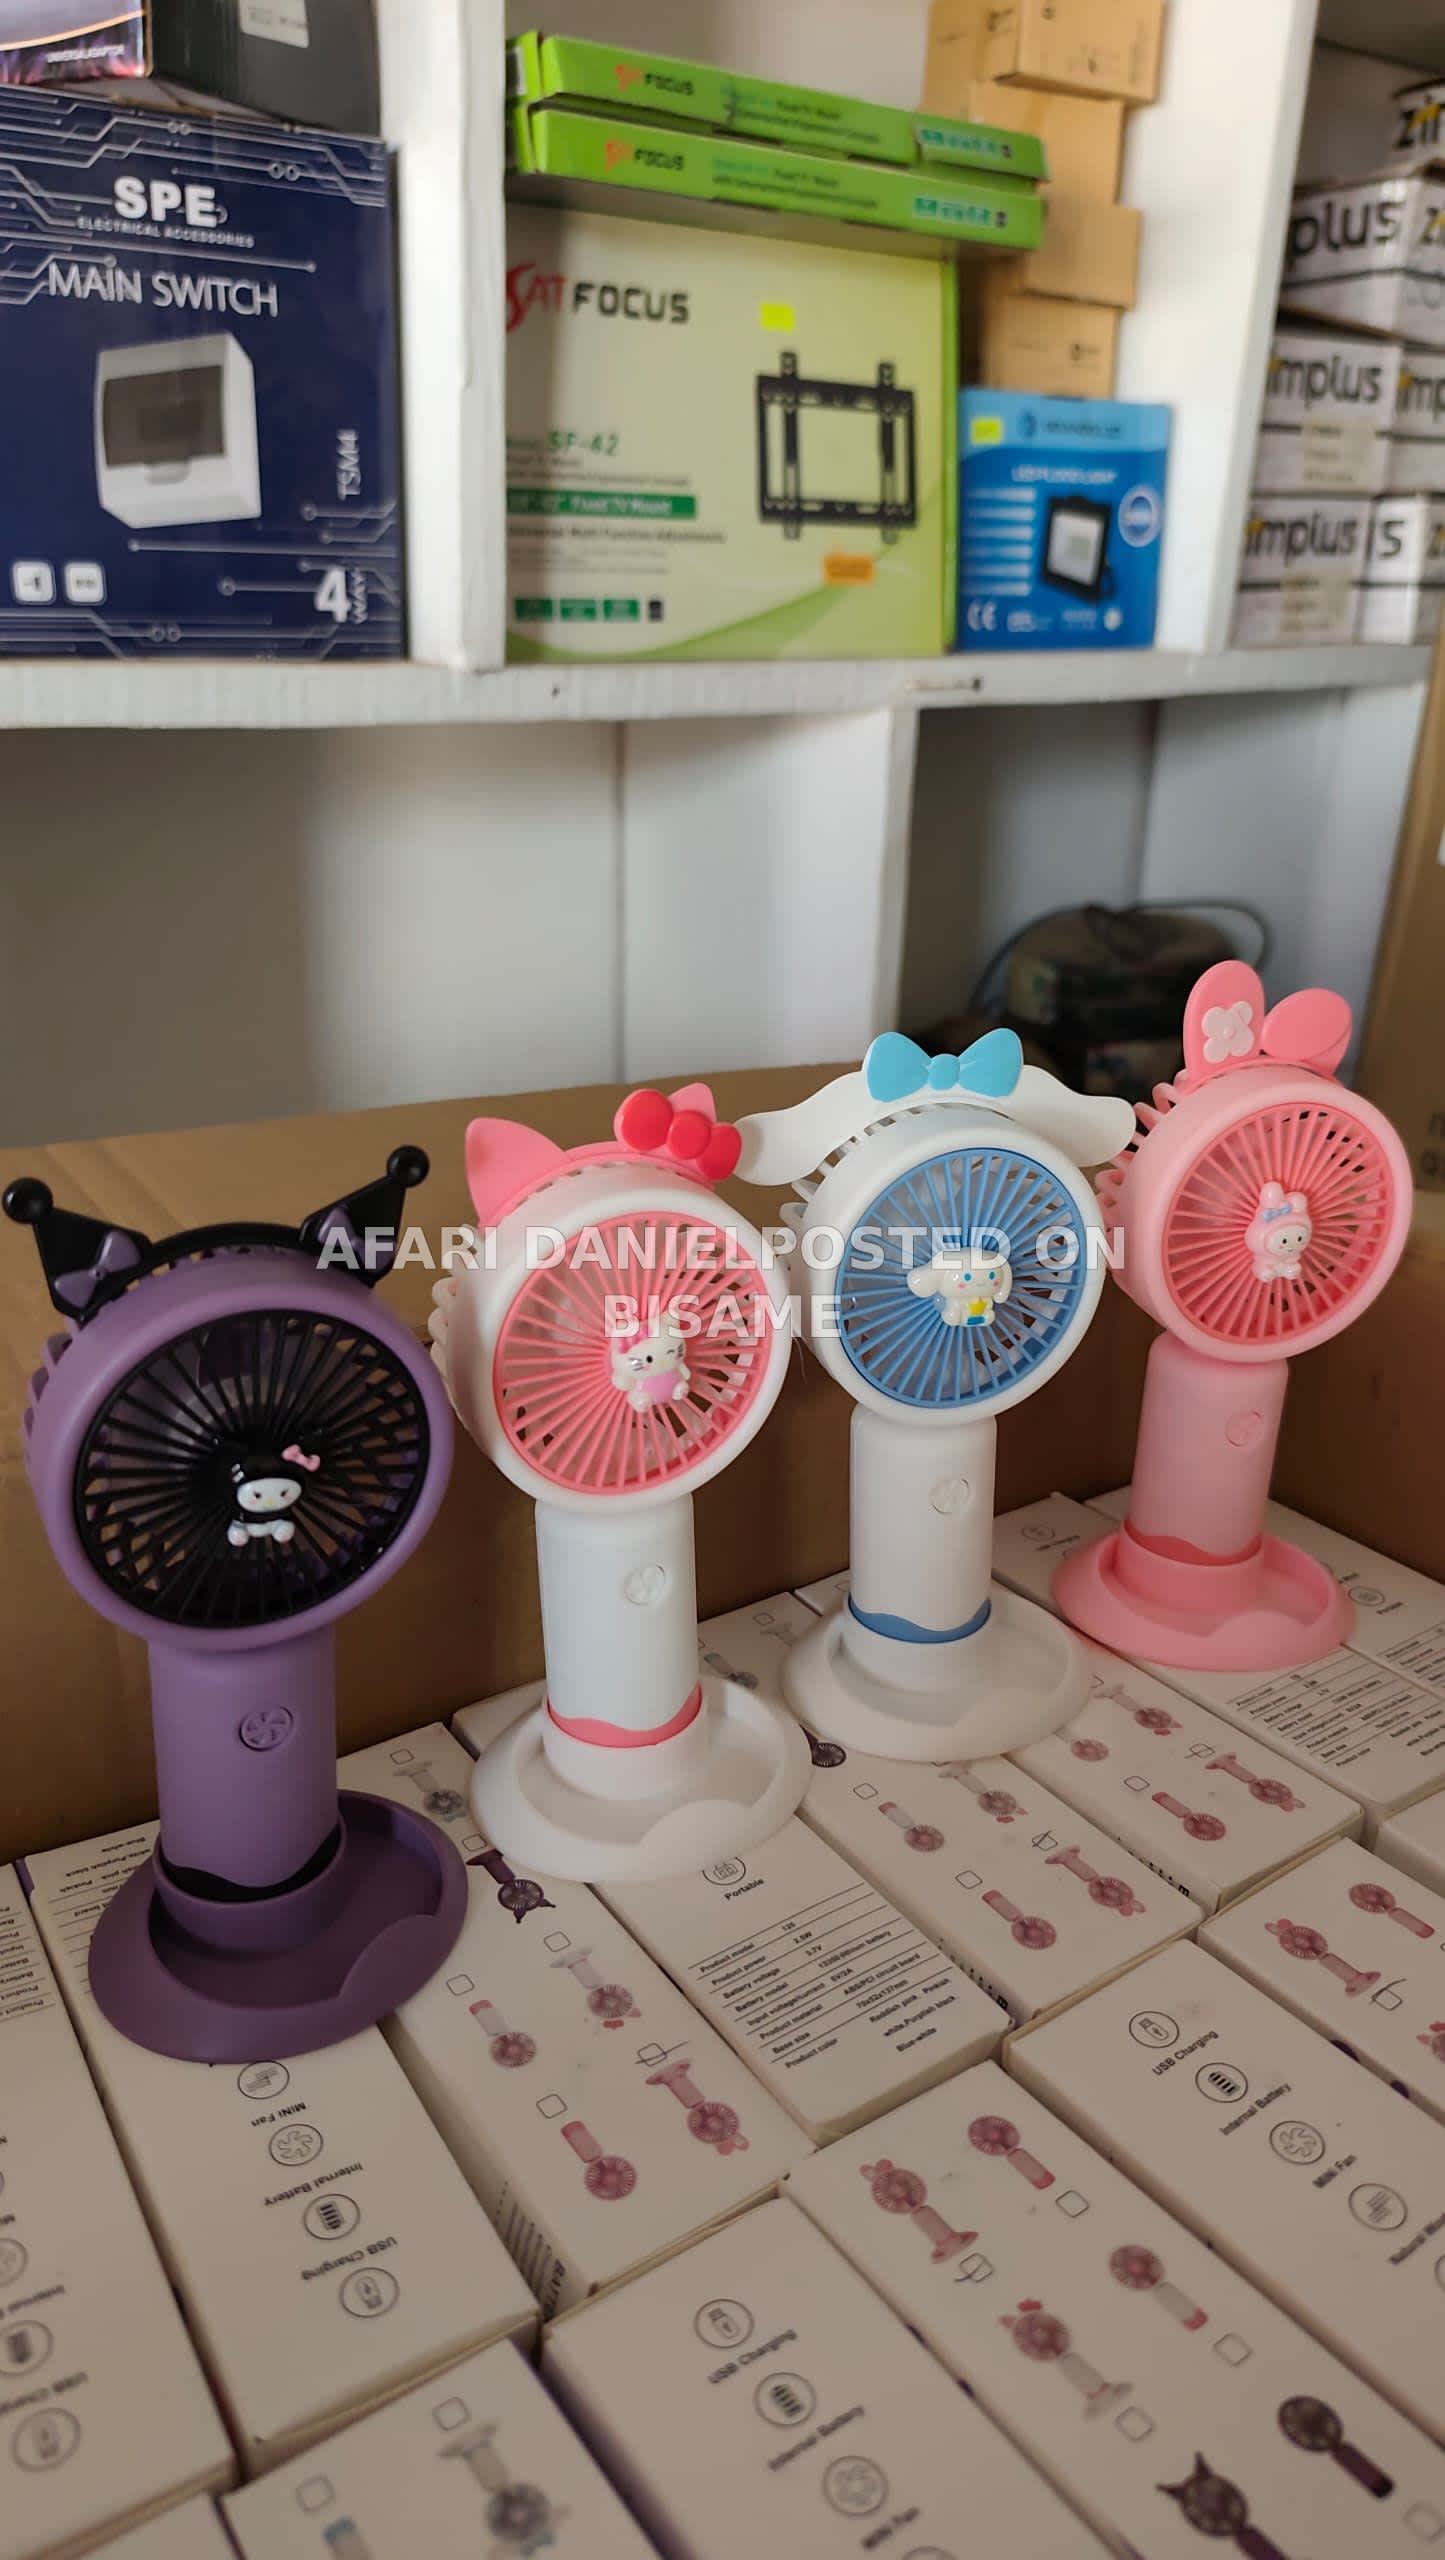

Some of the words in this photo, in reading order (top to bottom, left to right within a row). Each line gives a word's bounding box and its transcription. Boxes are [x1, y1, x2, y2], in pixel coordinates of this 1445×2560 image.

[645, 73, 695, 96] FOCUS
[634, 148, 684, 171] FOCUS
[114, 176, 217, 228] SPE
[77, 216, 161, 238] ELECTRICAL
[164, 226, 255, 248] ACCESSORIES
[48, 263, 143, 303] MAIN
[152, 272, 279, 317] SWITCH
[572, 282, 690, 323] FOCUS
[314, 566, 352, 622] 4
[724, 1877, 765, 1901] Portable
[699, 1955, 731, 1973] Product
[730, 1944, 755, 1957] model
[711, 1968, 742, 1985] Product
[722, 1983, 752, 1999] Battery
[734, 1996, 764, 2013] Battery
[758, 2021, 792, 2040] Product
[784, 2050, 818, 2069] Product
[1152, 2057, 1176, 2076] USB
[1174, 2030, 1219, 2060] Charging
[1255, 2083, 1292, 2109] Battery
[251, 2112, 276, 2127] Fan
[279, 2102, 307, 2119] MINI
[315, 2162, 363, 2188] Internal
[264, 2182, 312, 2207] Battery
[367, 2235, 397, 2256] USB
[301, 2249, 365, 2281] Charging
